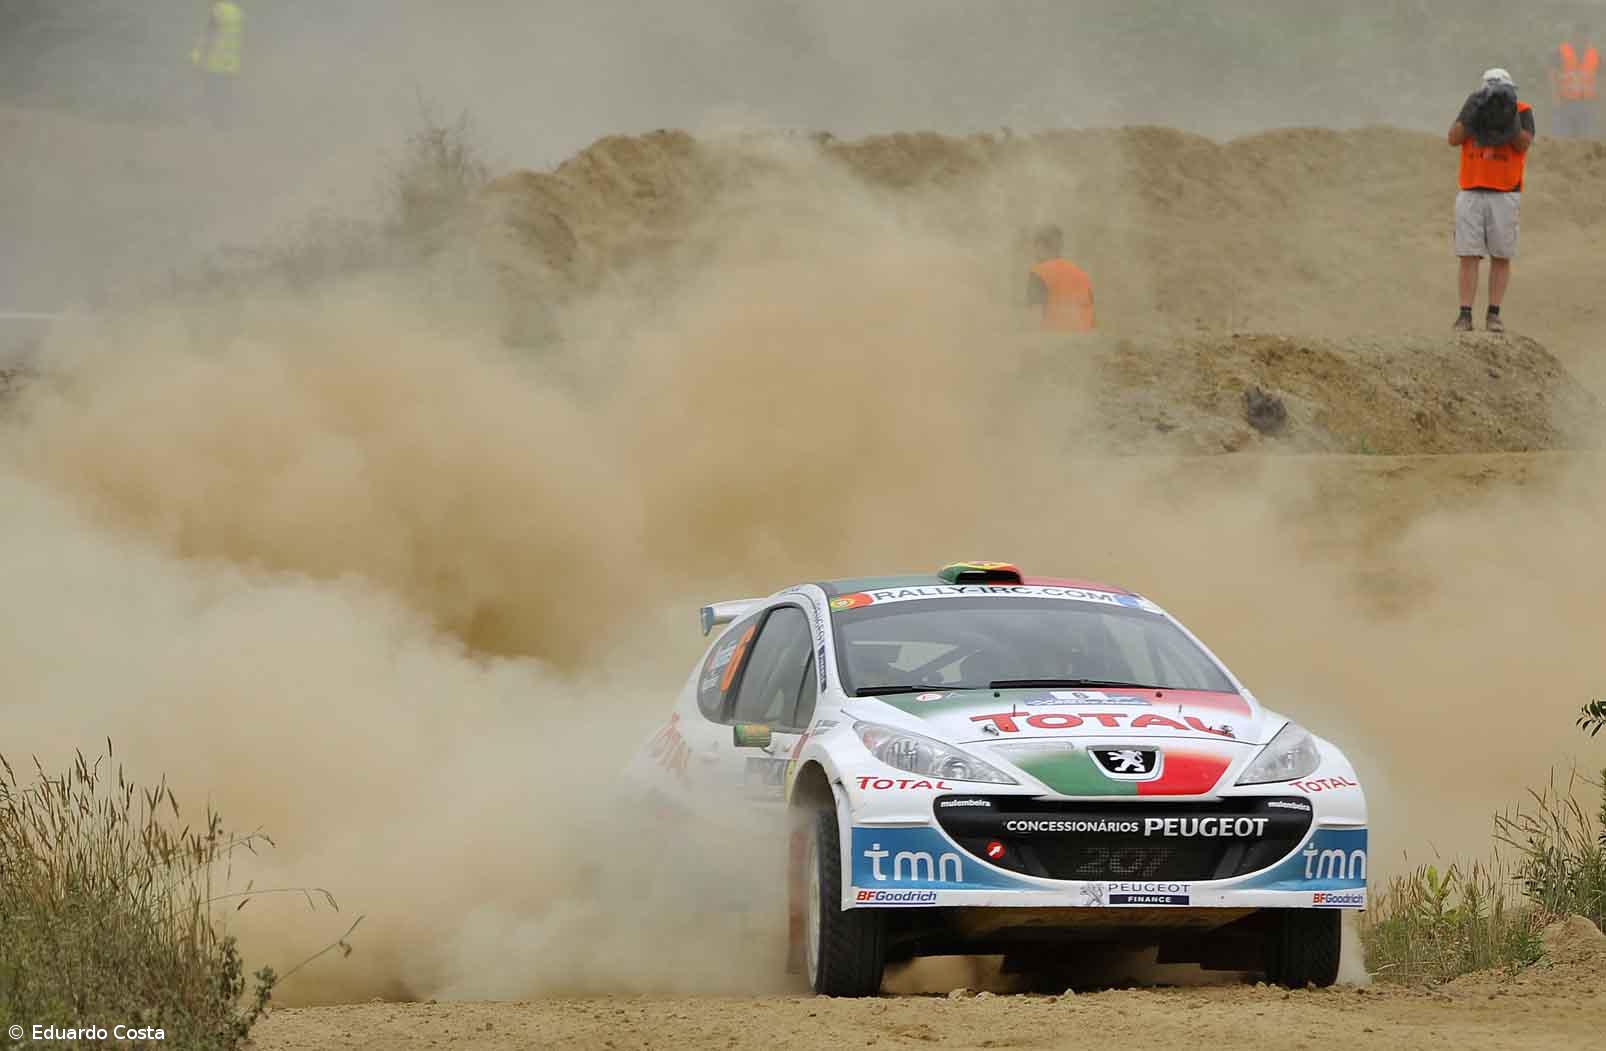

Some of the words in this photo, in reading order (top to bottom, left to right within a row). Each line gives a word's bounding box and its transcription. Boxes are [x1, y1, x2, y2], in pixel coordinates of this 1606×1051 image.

[873, 585, 1113, 602] RALLY-IRC.COM
[969, 711, 1236, 739] TOTAL
[856, 776, 953, 791] TOTAL
[1288, 775, 1358, 794] TOTAL
[1006, 818, 1140, 833] CONCESSIONÁRIOS
[1143, 817, 1269, 837] PEUGEOT
[863, 843, 963, 882] tmn
[1302, 842, 1368, 880] tmn
[856, 890, 937, 902] BFGoodrich
[1108, 882, 1192, 893] PEUGEOT
[1127, 895, 1173, 903] FINANCE
[1312, 892, 1364, 904] BFGoodrich
